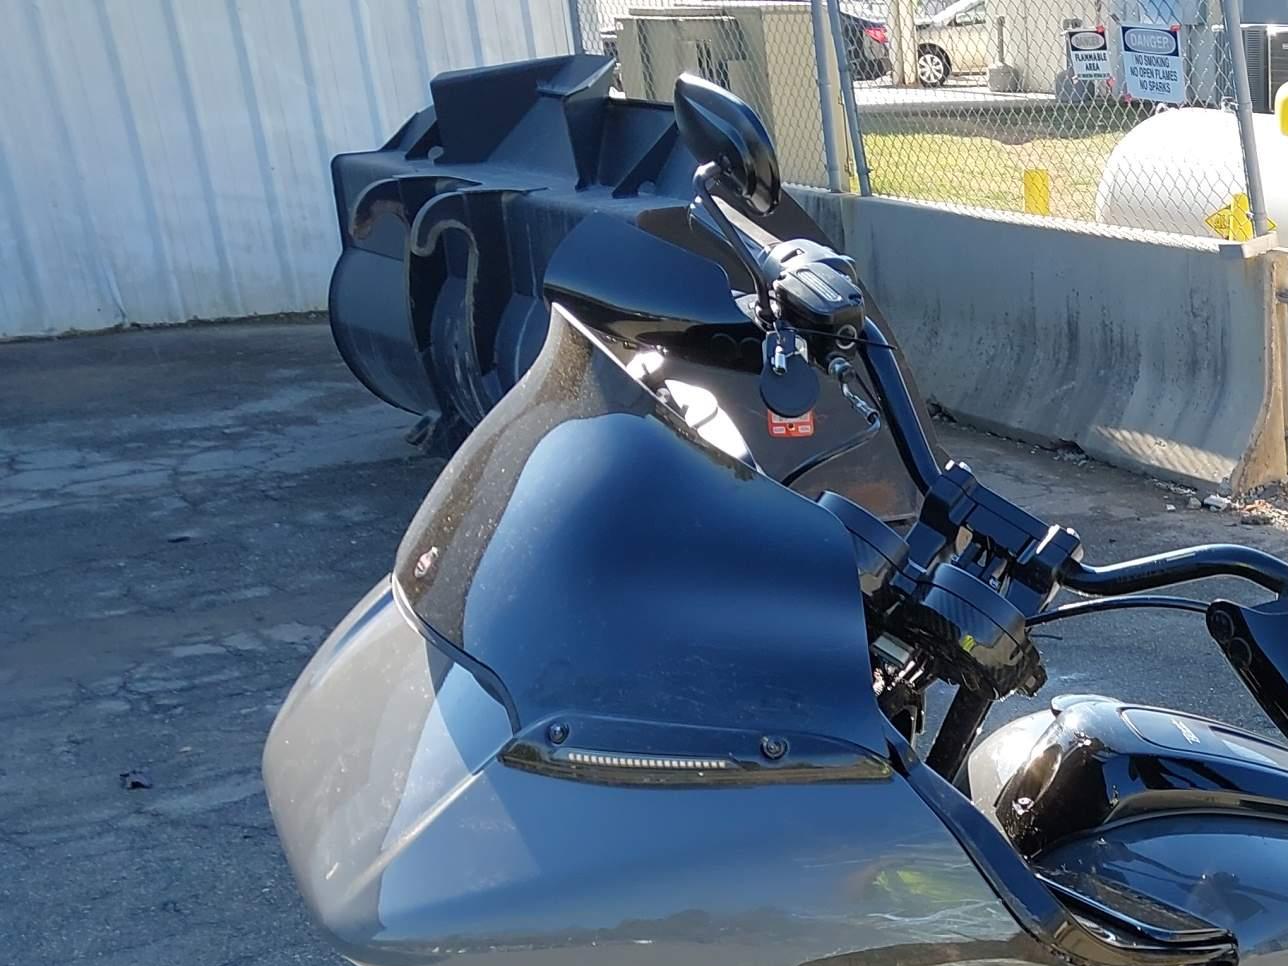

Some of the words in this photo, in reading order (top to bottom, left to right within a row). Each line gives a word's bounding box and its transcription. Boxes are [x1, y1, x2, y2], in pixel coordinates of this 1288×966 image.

[1130, 33, 1169, 49] DANGER
[1075, 52, 1107, 61] FLAMMABLE
[1135, 54, 1143, 66] NO
[1144, 55, 1170, 68] SMOKING
[1086, 62, 1101, 71] AREA
[1130, 66, 1138, 77] NO
[1140, 67, 1154, 79] OPEN
[1155, 69, 1178, 82] FLAMES
[1140, 80, 1148, 90] NO
[1149, 80, 1171, 93] SPARKS
